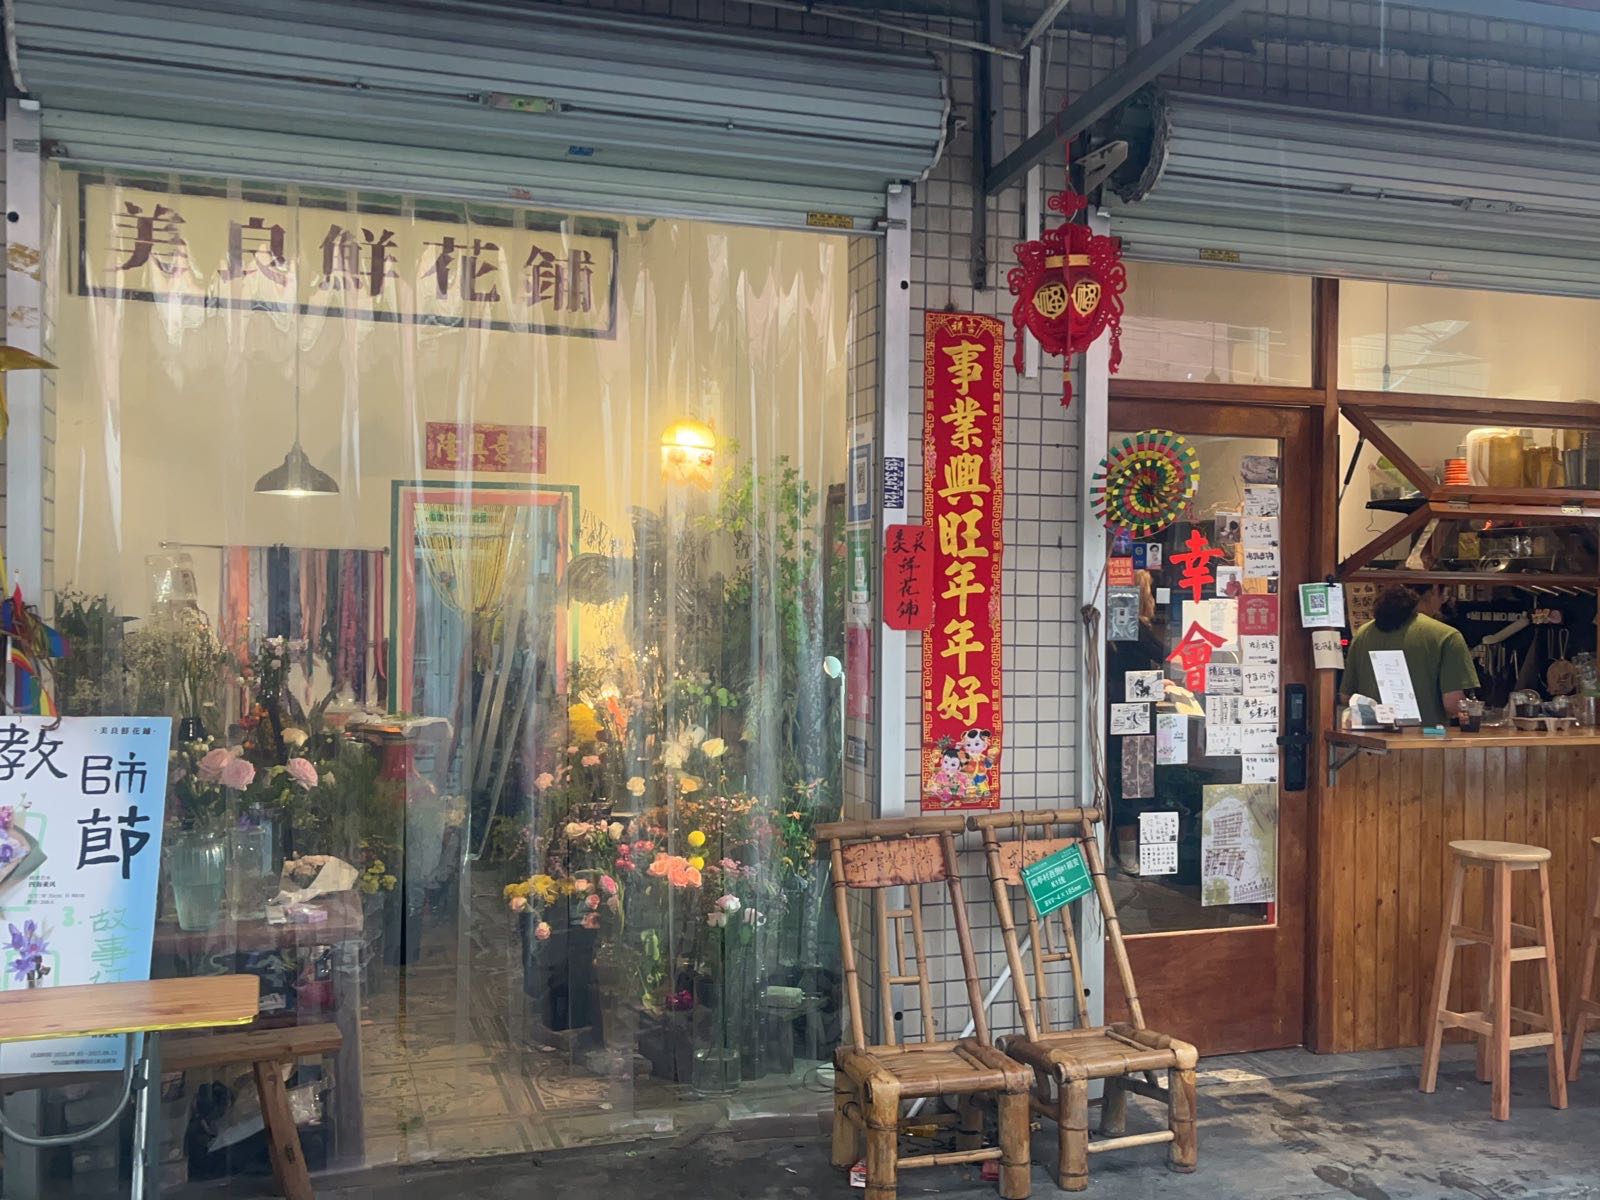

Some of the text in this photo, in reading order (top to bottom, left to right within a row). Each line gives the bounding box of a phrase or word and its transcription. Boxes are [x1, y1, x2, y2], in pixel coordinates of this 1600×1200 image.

[1039, 287, 1066, 314] 福
[936, 340, 991, 727] 事業興旺年年好
